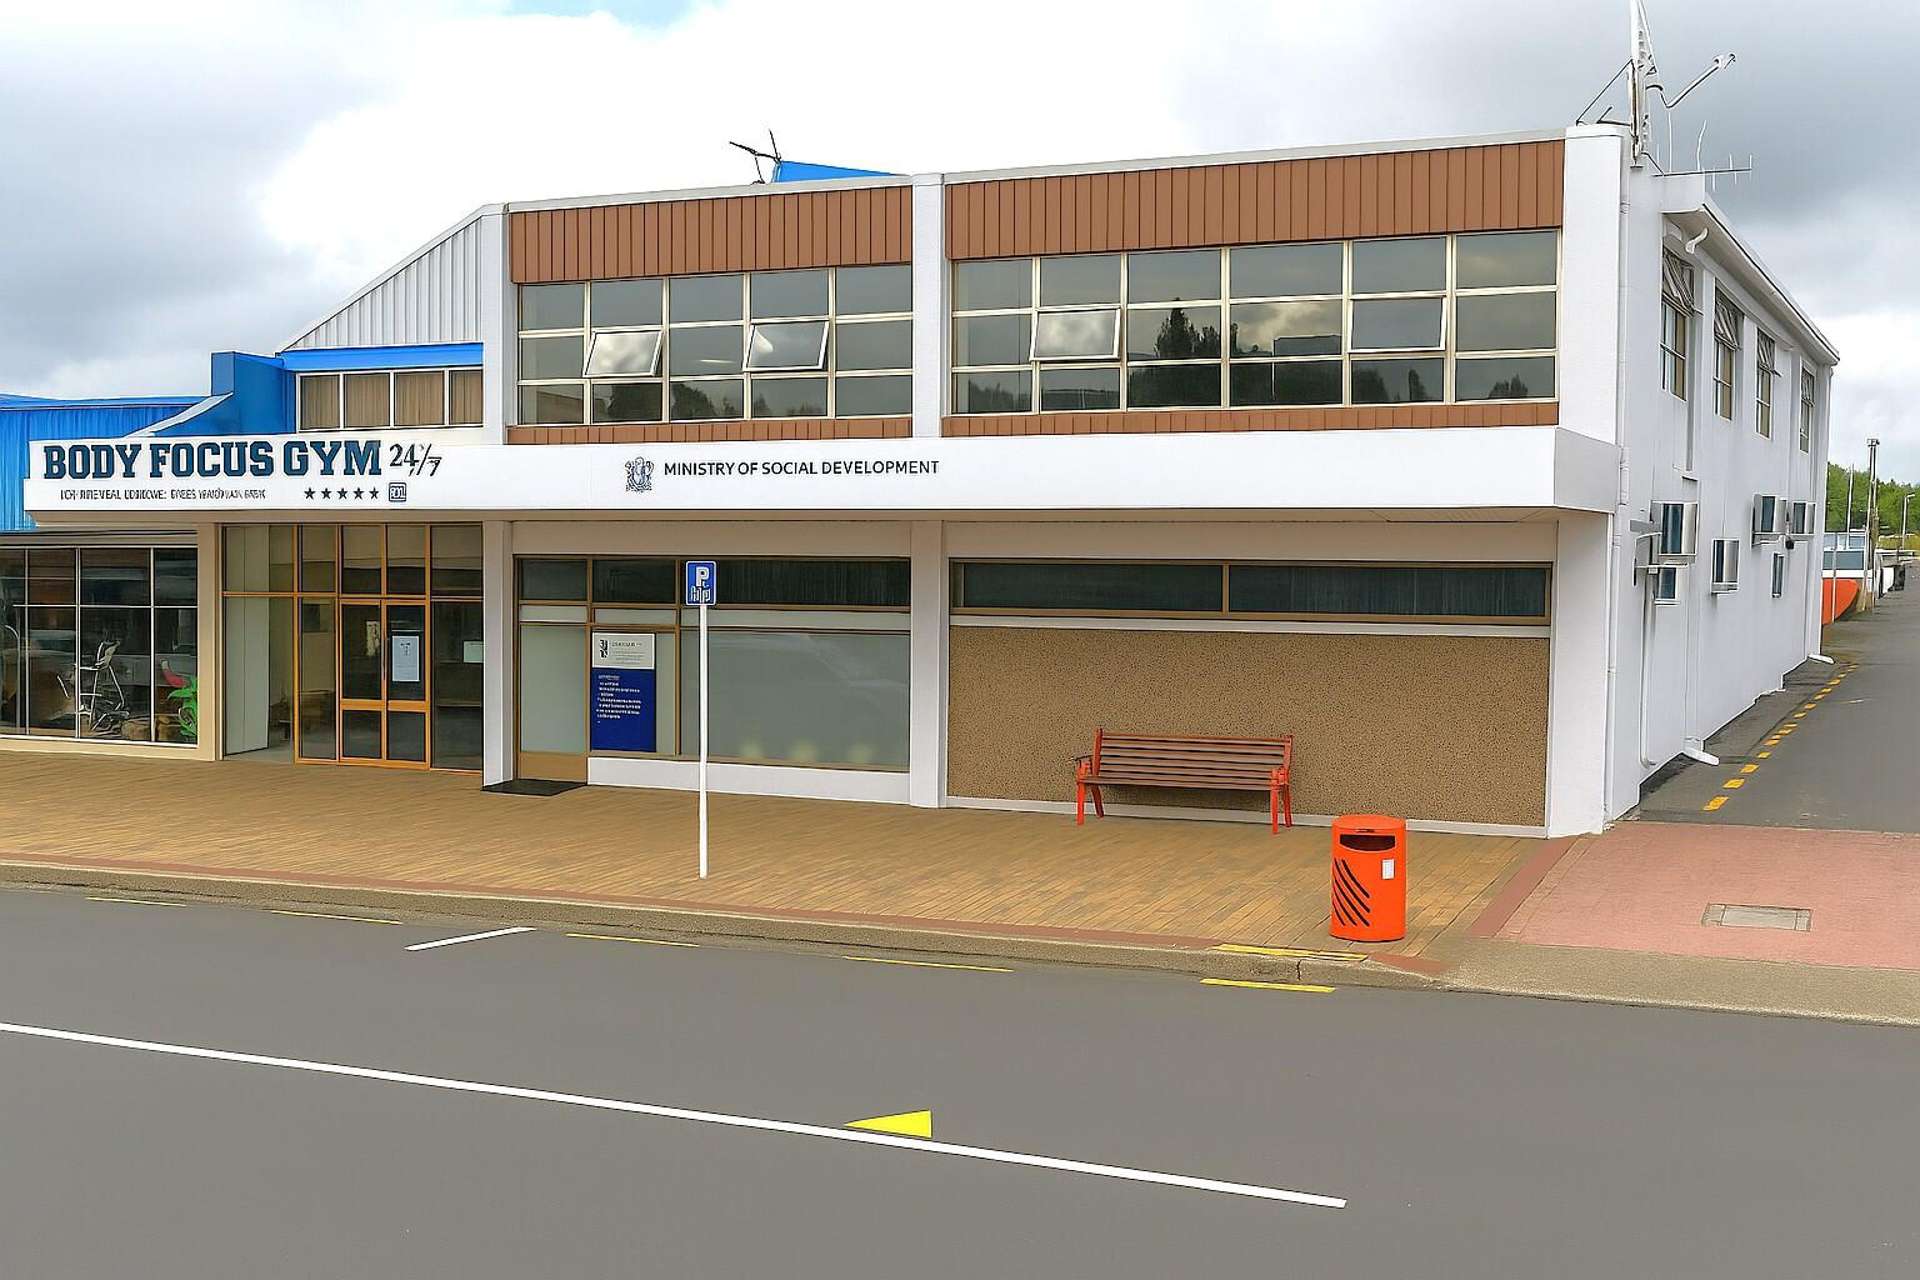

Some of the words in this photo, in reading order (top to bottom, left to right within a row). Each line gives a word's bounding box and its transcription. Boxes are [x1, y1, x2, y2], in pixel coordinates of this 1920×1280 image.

[44, 443, 140, 480] BODY
[149, 440, 275, 479] FOCUS
[283, 439, 382, 477] GYM
[389, 442, 442, 478] 24/7
[664, 461, 736, 477] MINISTRY
[737, 461, 759, 476] OF
[761, 461, 818, 476] SOCIAL
[821, 460, 940, 475] DEVELOPMENT
